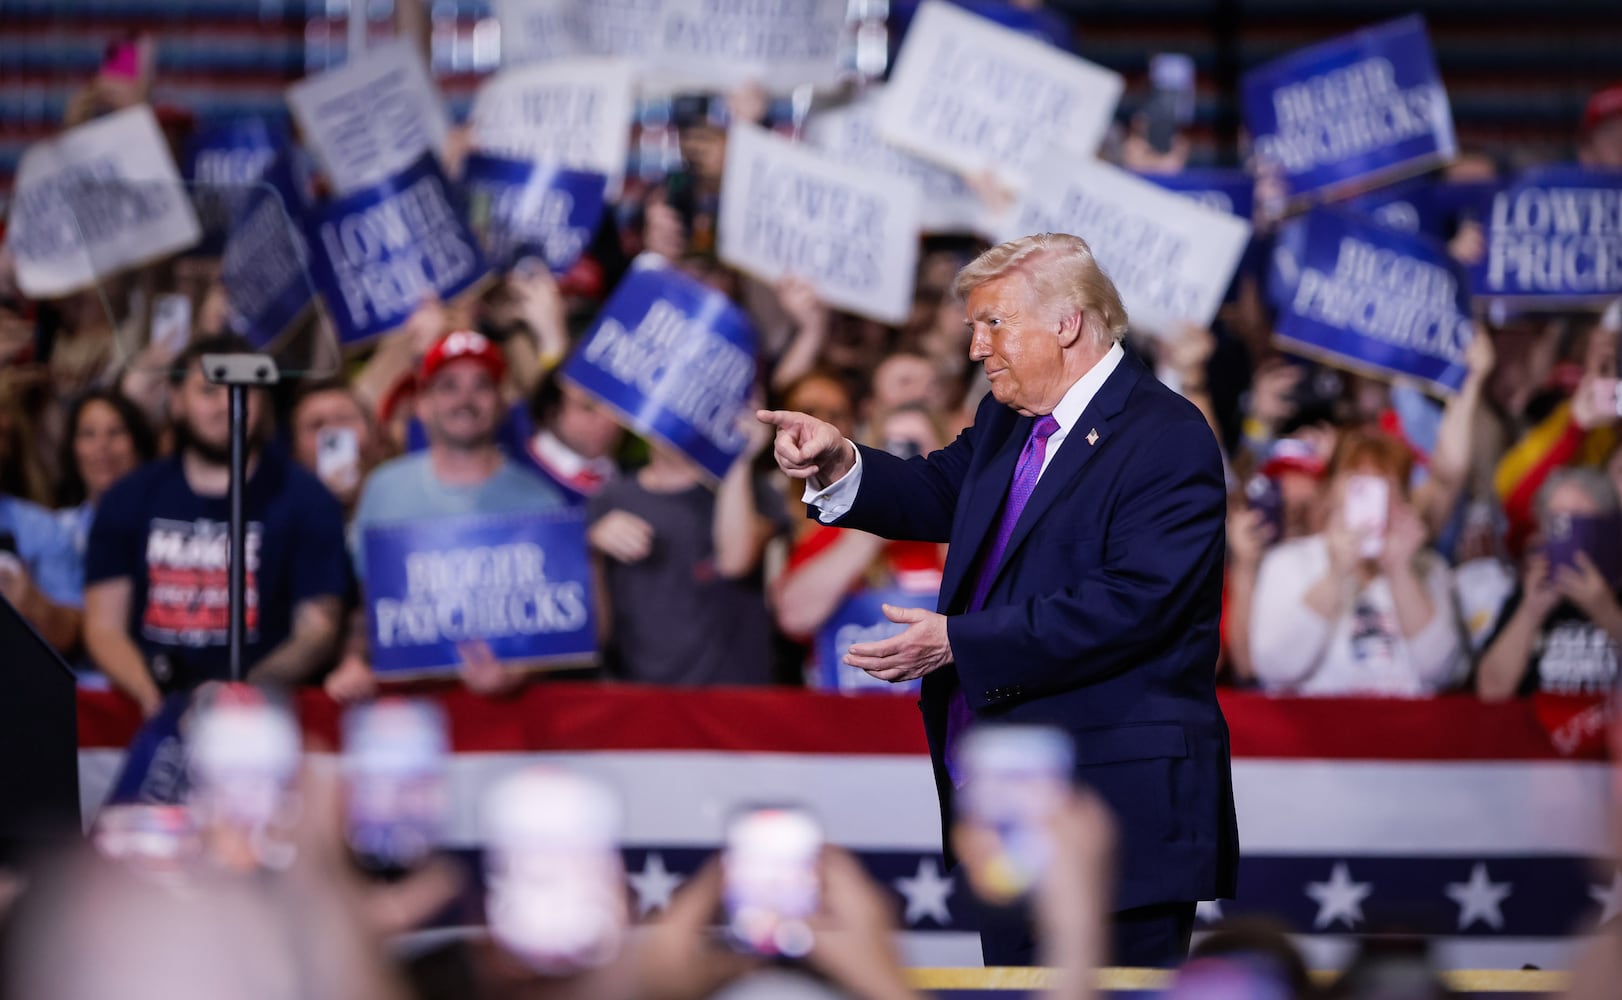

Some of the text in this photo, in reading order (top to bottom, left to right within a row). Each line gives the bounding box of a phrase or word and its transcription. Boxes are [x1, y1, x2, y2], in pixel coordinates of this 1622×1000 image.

[910, 89, 1042, 167] PRICE
[320, 173, 455, 270] LOWER
[342, 228, 478, 331] PRICES
[405, 543, 546, 600] BIGGER
[376, 581, 588, 648] PAYCHECKS
